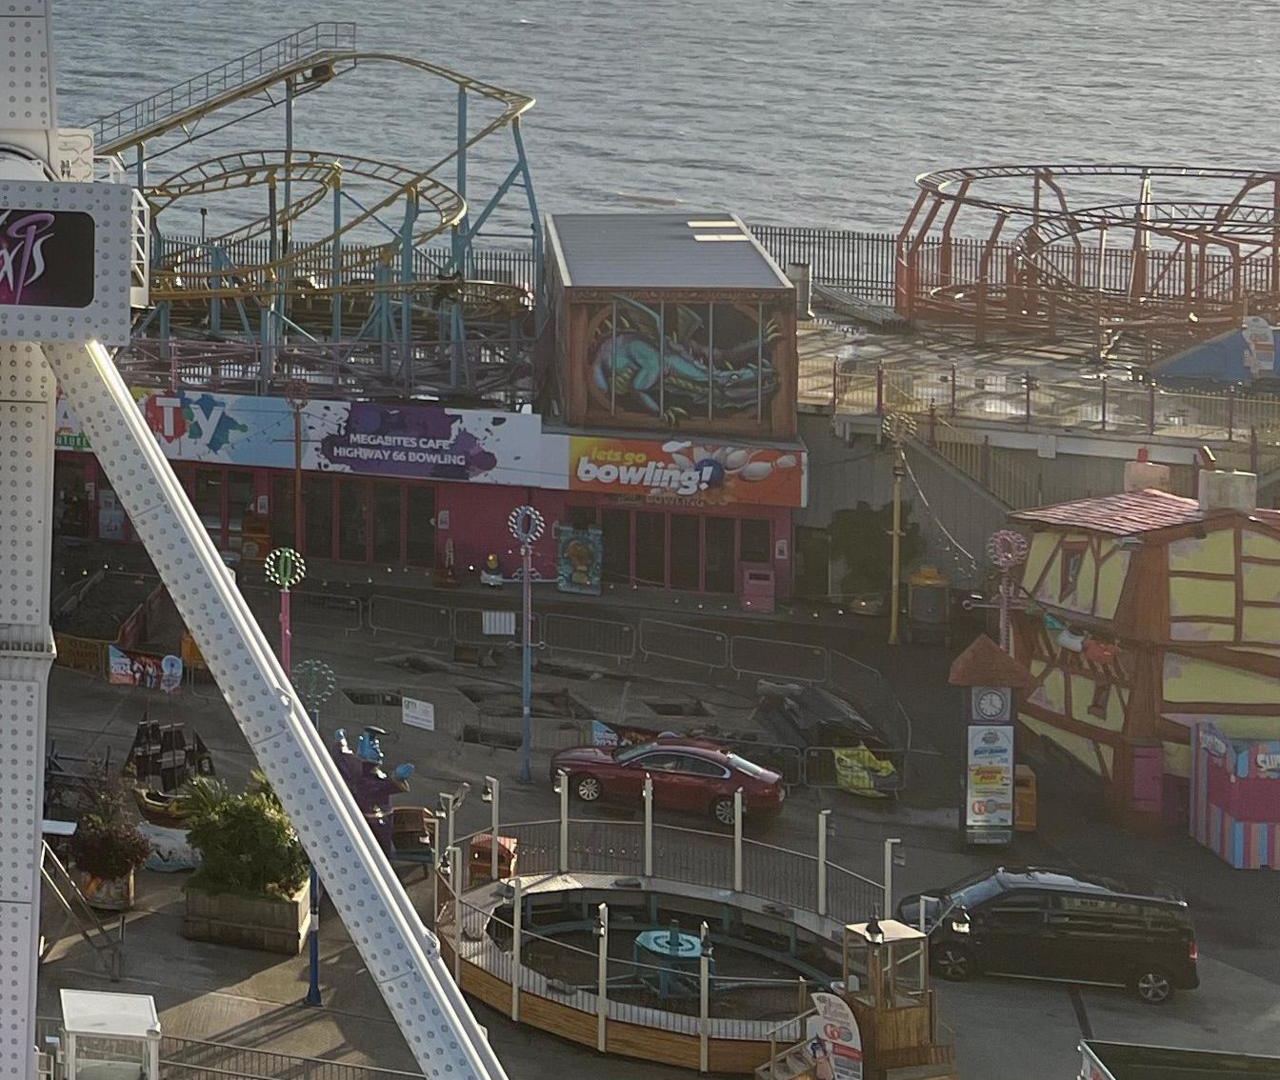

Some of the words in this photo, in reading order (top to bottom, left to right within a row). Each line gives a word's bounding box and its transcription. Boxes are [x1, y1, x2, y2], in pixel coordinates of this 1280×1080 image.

[349, 433, 417, 449] MEGABITES
[333, 446, 391, 461] HIGHWAY
[392, 451, 406, 462] 66
[408, 451, 466, 466] BOWLING
[591, 446, 623, 462] lets
[624, 451, 647, 465] go
[577, 456, 714, 496] bowling!
